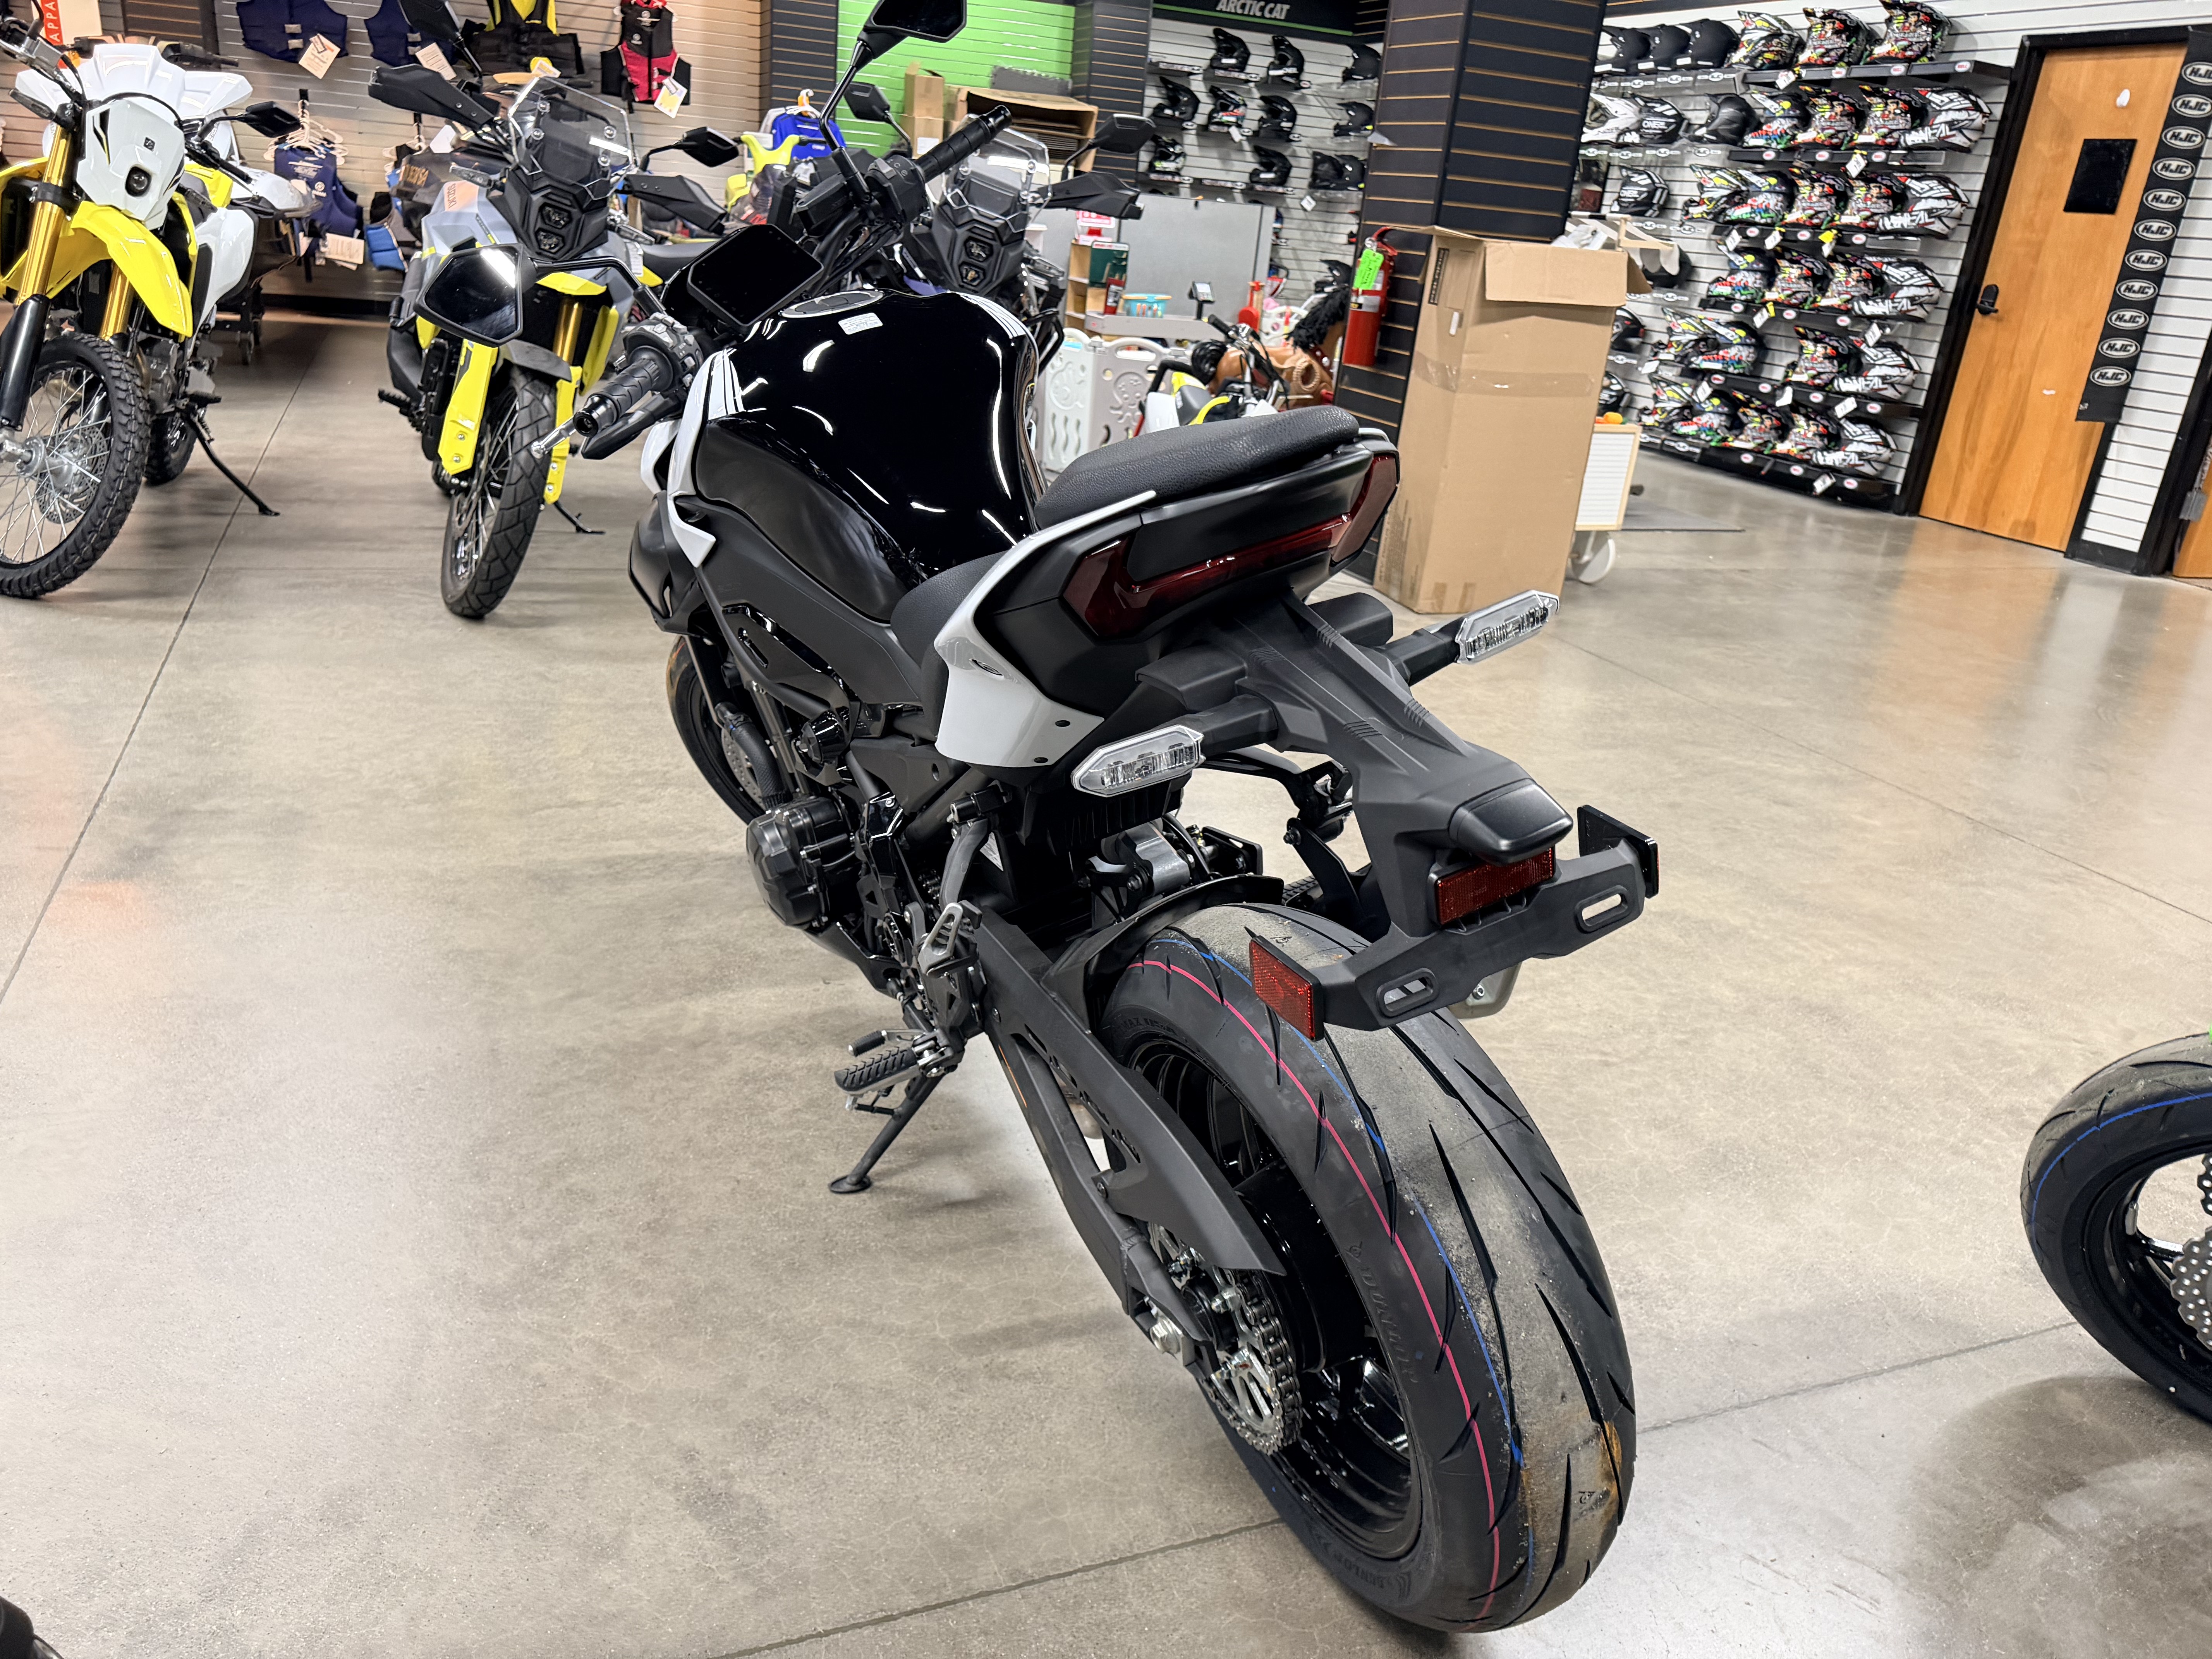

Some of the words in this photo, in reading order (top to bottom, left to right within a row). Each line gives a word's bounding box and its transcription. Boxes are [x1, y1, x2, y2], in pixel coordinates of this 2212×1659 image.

[1216, 0, 1266, 16] ARCTIC
[1264, 3, 1290, 19] CAT
[447, 183, 457, 209] SUZUKI
